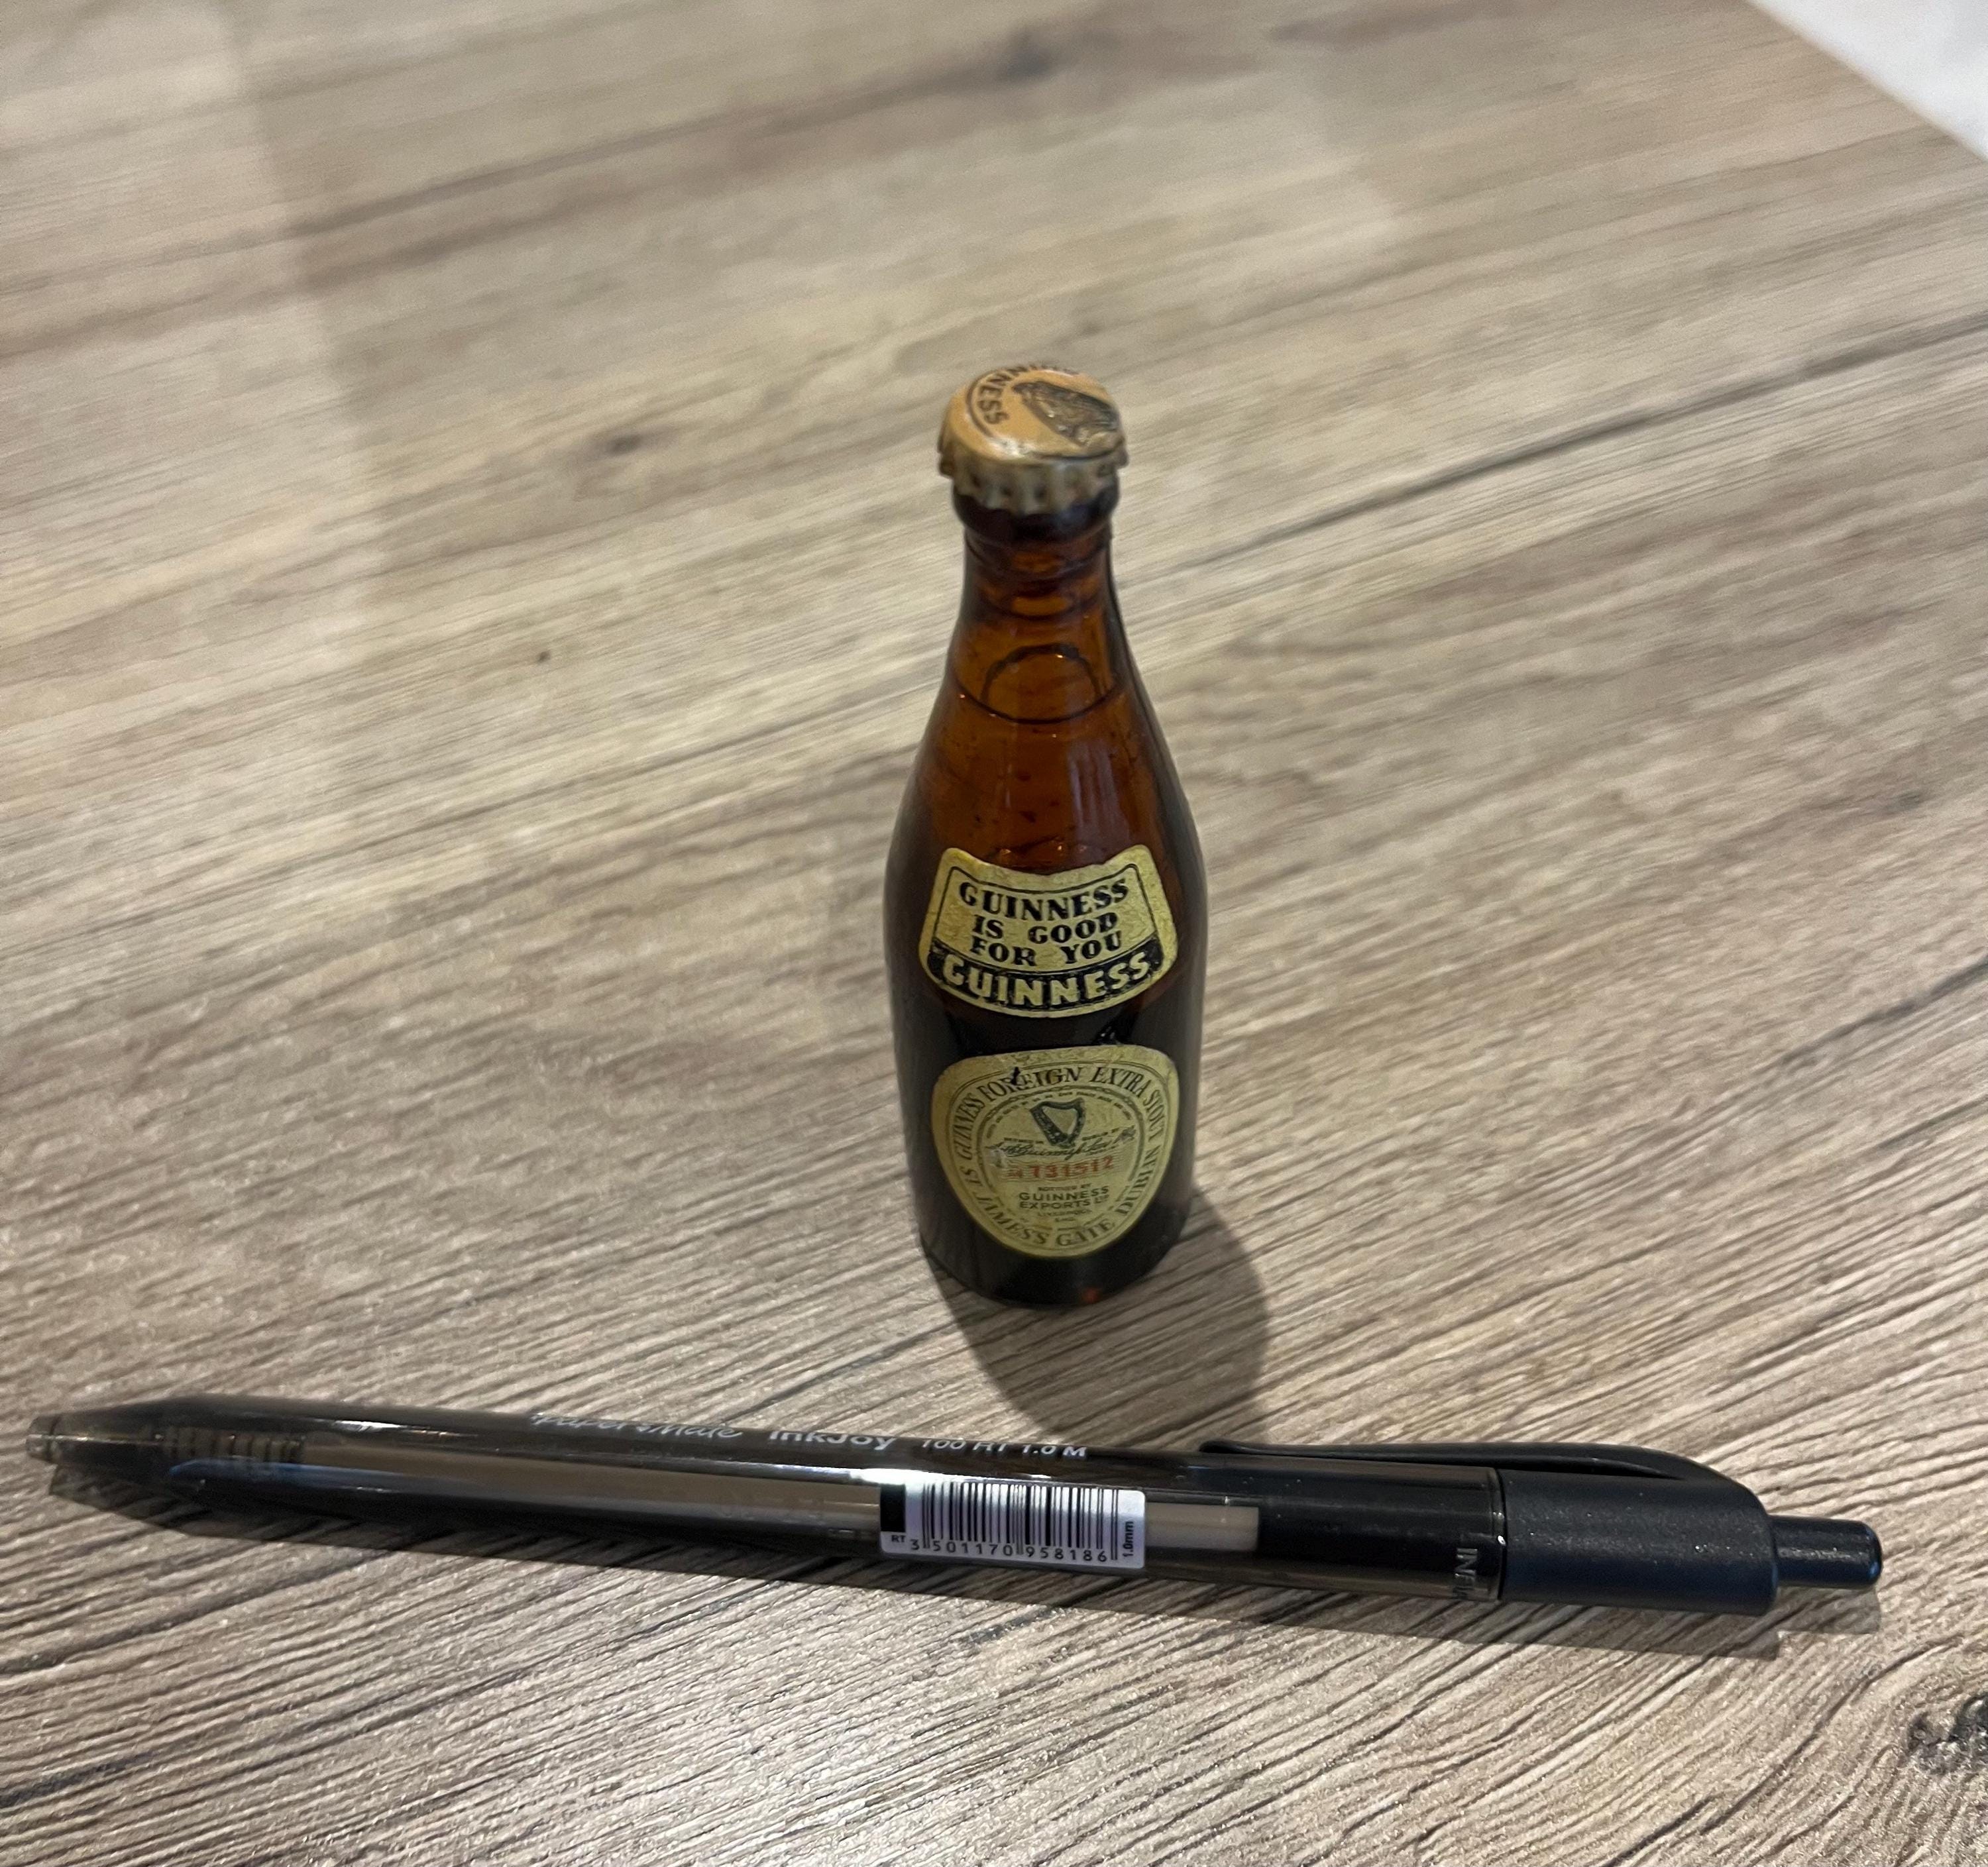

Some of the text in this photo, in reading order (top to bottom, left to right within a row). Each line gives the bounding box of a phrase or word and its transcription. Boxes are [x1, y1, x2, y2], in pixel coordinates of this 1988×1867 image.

[959, 878, 1129, 922] GUINNESS
[972, 911, 1119, 944] IS GOOD
[969, 930, 1123, 967] FOR YOU
[943, 951, 1150, 1006] GUINNESS
[953, 1093, 986, 1160] GUINNESS
[976, 1067, 1083, 1102] FOREIGN
[1089, 1066, 1152, 1098] EXTRA
[1142, 1089, 1165, 1143] STOUT
[1019, 1185, 1110, 1201] GUINNESS
[1019, 1199, 1091, 1210] EXPORTS
[1055, 1218, 1116, 1247] GATE
[922, 1439, 967, 1450] 100
[1021, 1444, 1057, 1455] 1.0
[1062, 1446, 1088, 1457] M
[891, 1534, 906, 1543] RT
[910, 1538, 1107, 1562] 3 501170 958186
[1123, 1521, 1134, 1558] 1.0mm
